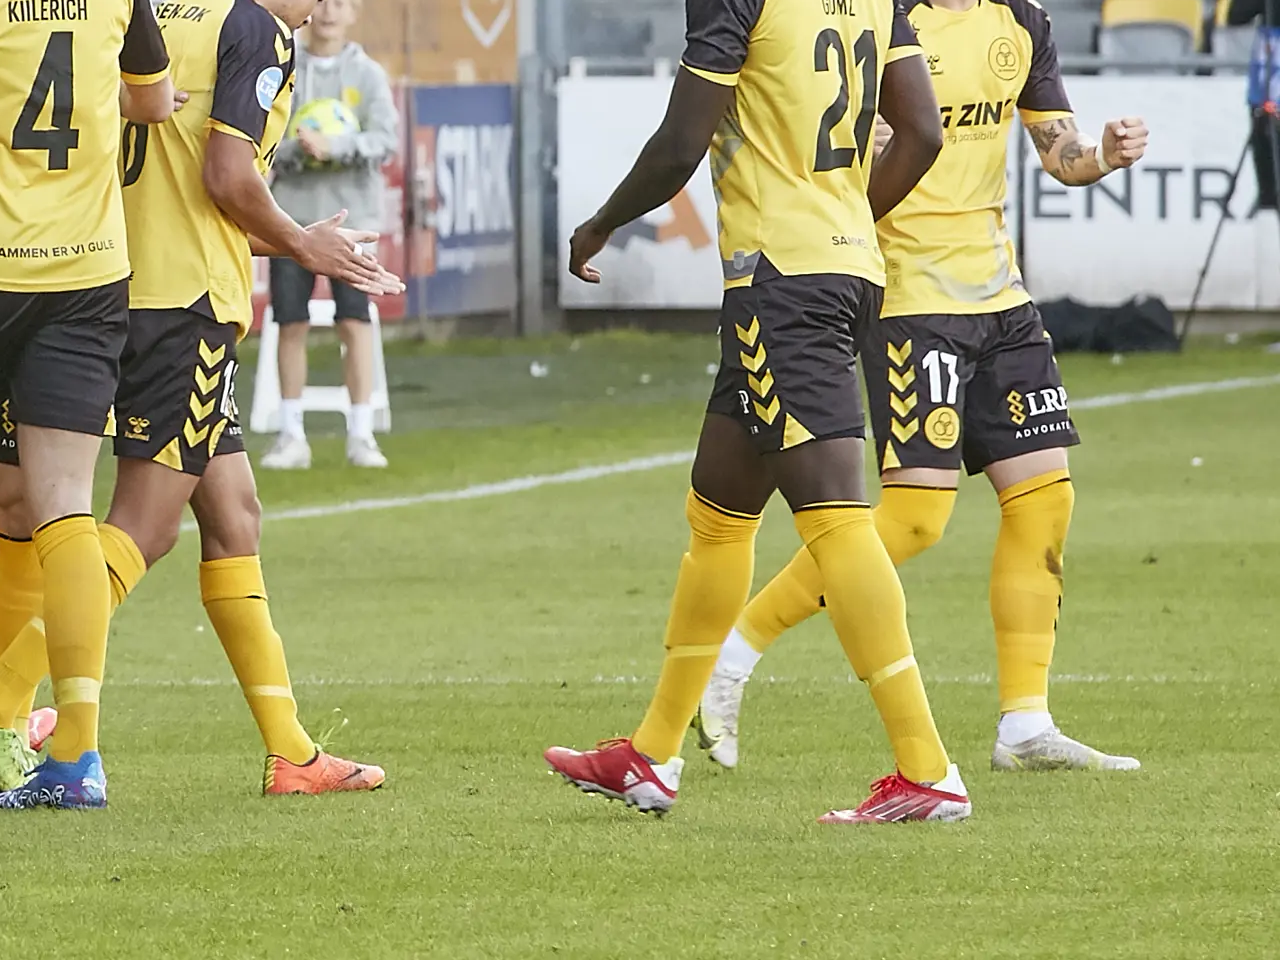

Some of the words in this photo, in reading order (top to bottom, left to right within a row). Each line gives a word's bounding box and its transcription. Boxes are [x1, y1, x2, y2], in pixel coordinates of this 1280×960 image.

[11, 30, 80, 171] 4
[258, 79, 277, 103] LIG
[812, 27, 878, 173] 21
[939, 105, 953, 129] G
[956, 98, 1013, 128] ZIN
[121, 119, 149, 188] 0
[52, 246, 69, 258] ER
[70, 243, 86, 256] VI
[88, 239, 115, 253] GULE
[921, 349, 960, 405] 17
